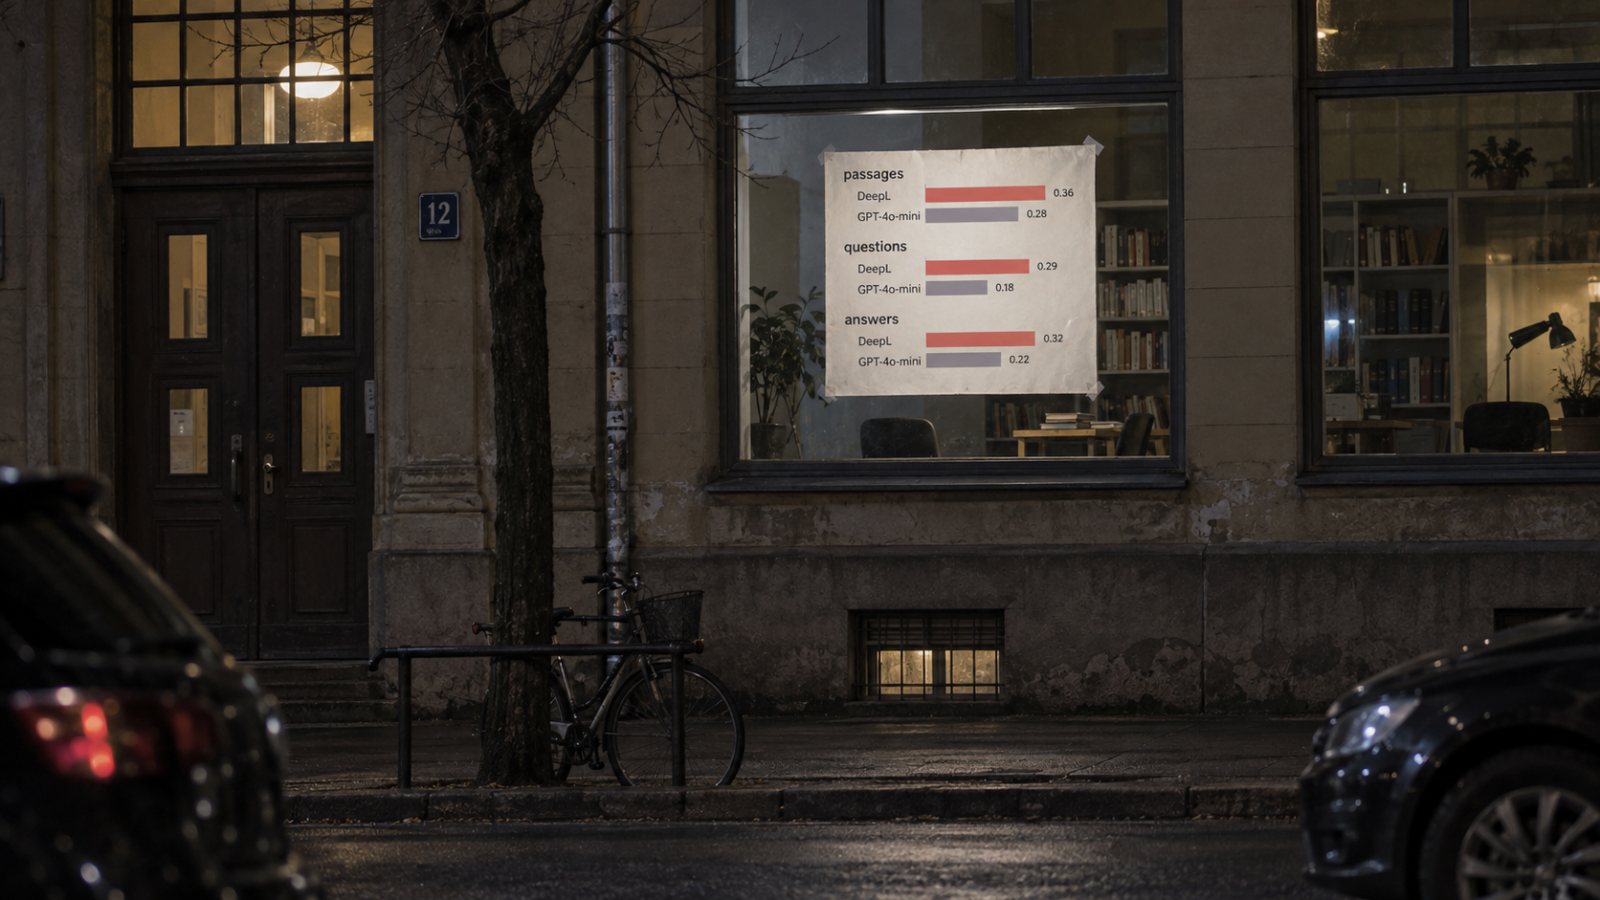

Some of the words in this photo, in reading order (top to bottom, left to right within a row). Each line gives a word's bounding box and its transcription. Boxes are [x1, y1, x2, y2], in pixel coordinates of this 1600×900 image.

[844, 169, 904, 182] passages
[857, 191, 891, 201] DeepL
[1054, 189, 1074, 197] 0.36
[427, 201, 450, 225] 12
[858, 211, 921, 222] GPT-4o-mini
[1027, 209, 1047, 218] 0.28
[844, 241, 907, 254] questions
[858, 264, 891, 274] DeepL
[1037, 262, 1057, 271] 0.29
[858, 284, 921, 295] GPT-4o-mini
[996, 283, 1014, 292] 0.18
[845, 314, 899, 325] answers
[858, 336, 892, 347] DeepL
[1044, 334, 1063, 343] 0.32
[858, 357, 922, 367] GPT-4o-mini
[1009, 355, 1029, 364] 0.22
